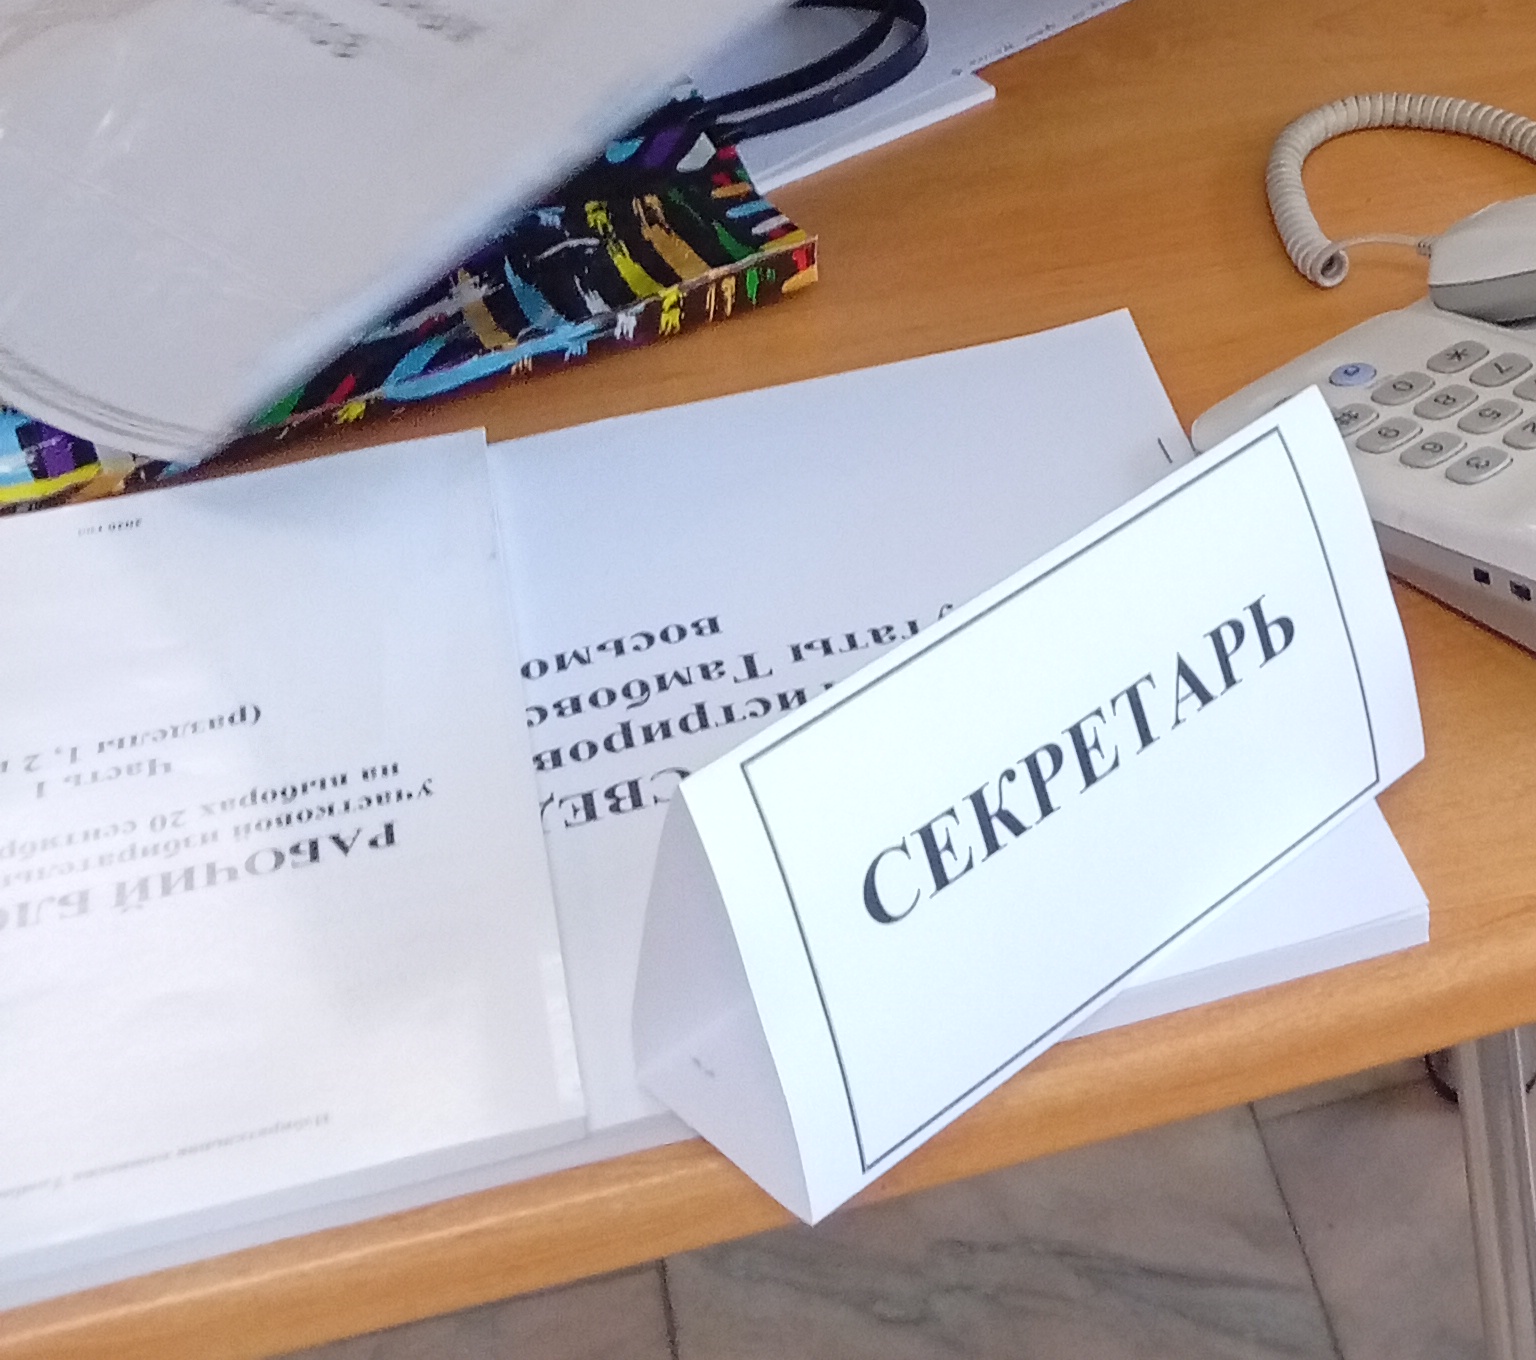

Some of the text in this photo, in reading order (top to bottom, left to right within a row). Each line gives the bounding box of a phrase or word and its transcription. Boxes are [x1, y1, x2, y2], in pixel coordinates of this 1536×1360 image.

[519, 614, 724, 681] восьмо
[525, 651, 774, 729] Тамбовс
[97, 703, 263, 755] (разделы
[532, 681, 833, 772] истриров
[23, 754, 41, 773] 2
[35, 758, 173, 800] Часть 1
[360, 761, 400, 782] на
[862, 593, 1296, 926] СЕКРЕТАРЬ
[149, 809, 187, 833] 20
[199, 771, 349, 817] выборах
[232, 777, 434, 844] участковой
[112, 820, 399, 914] РАБОЧИЙ
